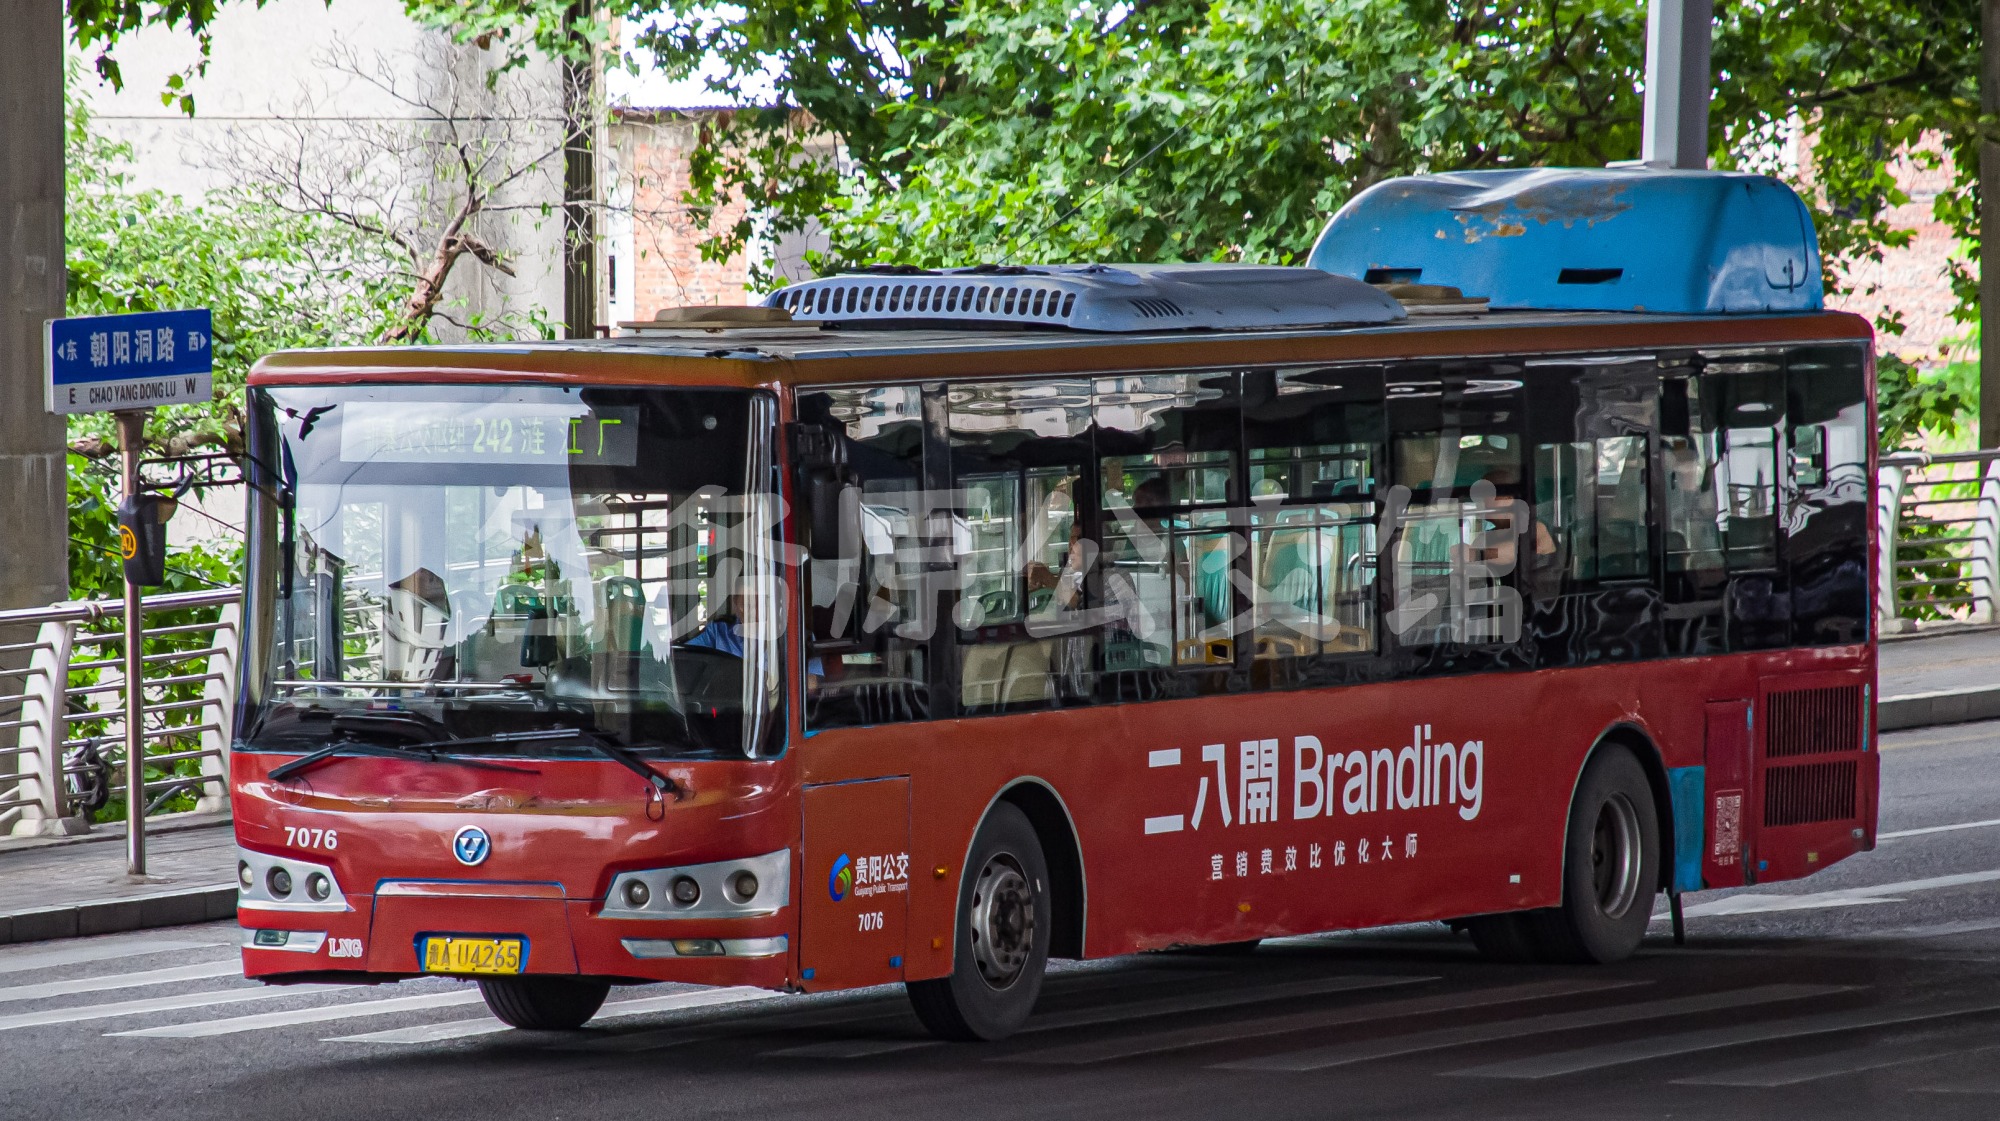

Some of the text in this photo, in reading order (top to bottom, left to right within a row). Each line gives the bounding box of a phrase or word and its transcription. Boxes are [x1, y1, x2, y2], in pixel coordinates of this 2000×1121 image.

[66, 326, 199, 368] 东 朝阳洞路 西
[69, 377, 196, 404] E CHAO YANG DONG LU W
[473, 417, 513, 454] 242
[1144, 724, 1484, 835] 二八開 Branding
[284, 826, 338, 850] 7076
[855, 852, 909, 885] 贵阳公交
[1210, 833, 1419, 881] 营销费效比优化大师
[858, 911, 883, 932] 7076
[328, 938, 363, 957] LNG
